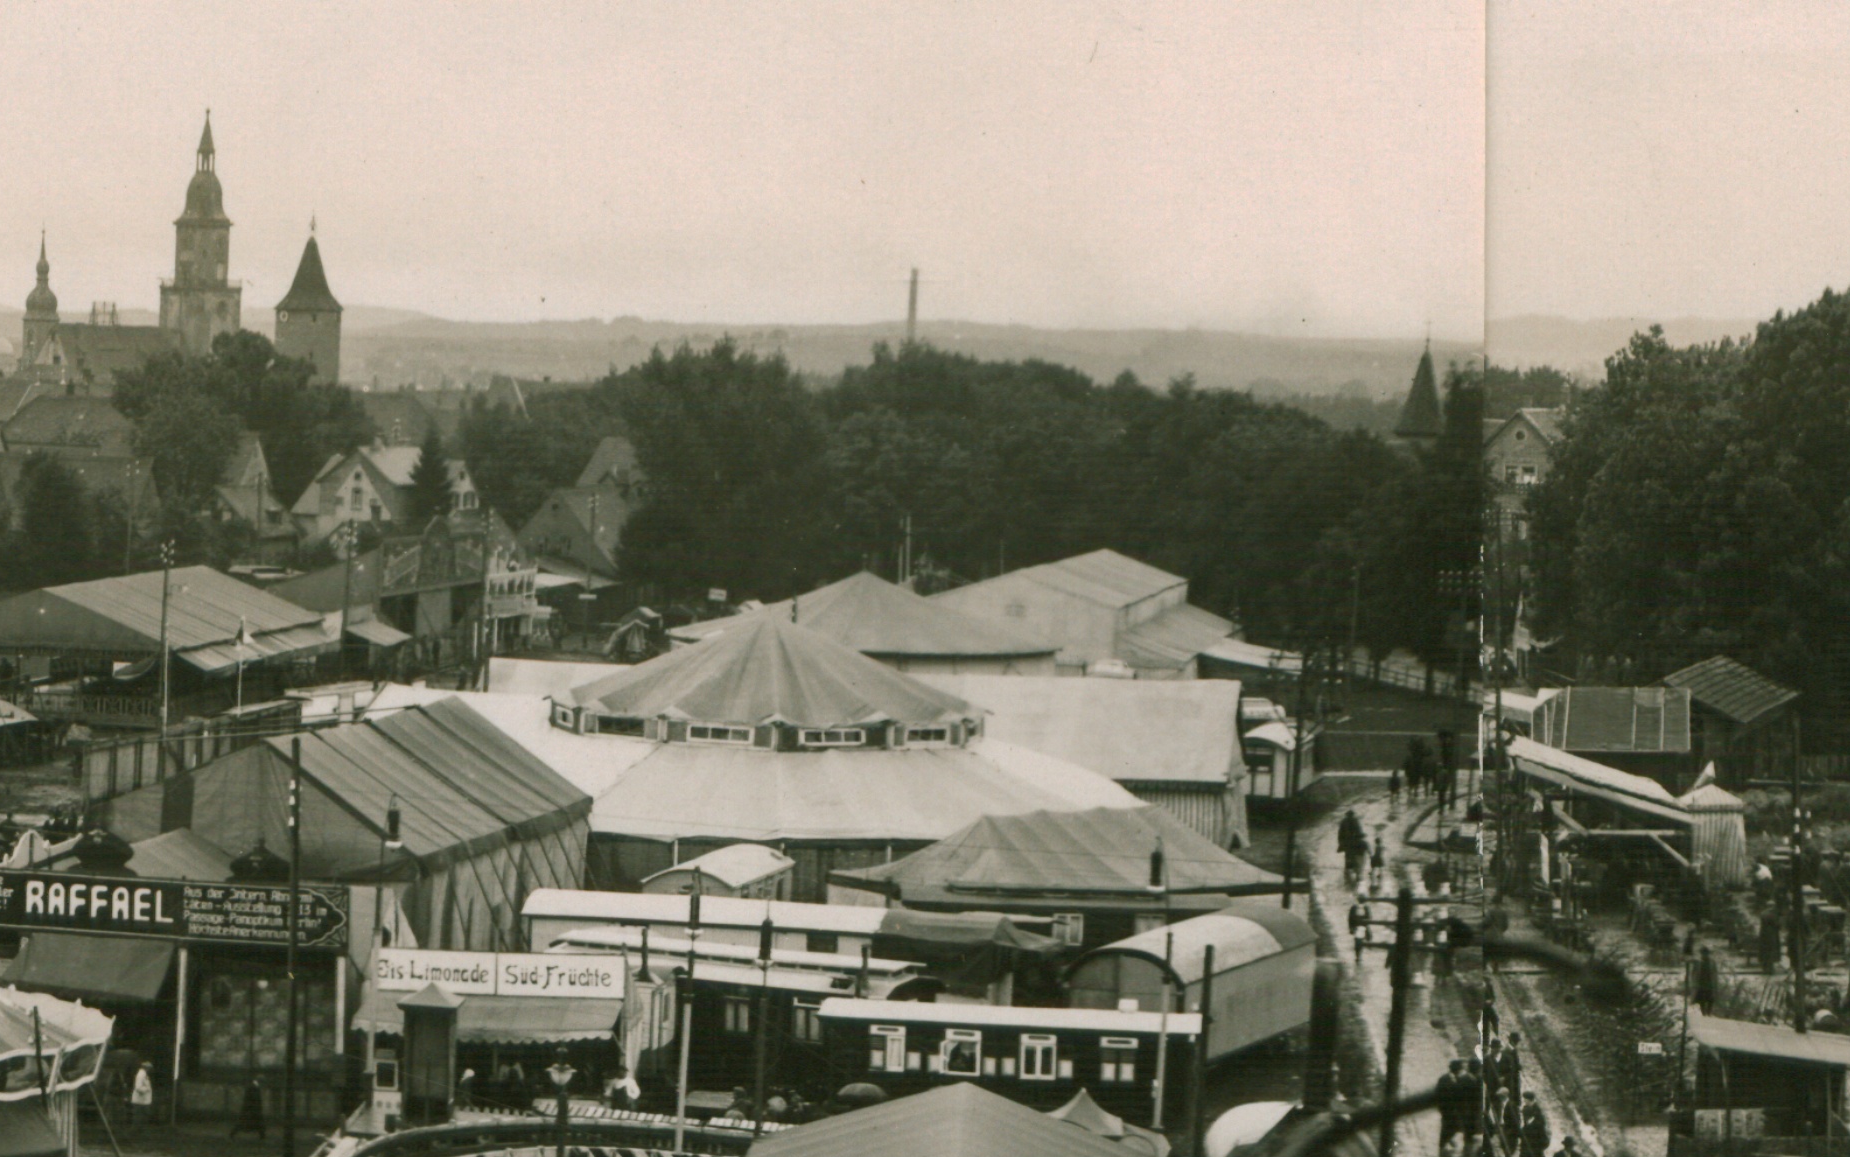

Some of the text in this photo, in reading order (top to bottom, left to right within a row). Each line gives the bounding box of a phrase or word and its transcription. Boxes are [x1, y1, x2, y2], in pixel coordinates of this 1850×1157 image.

[26, 880, 174, 923] RAFFAEL
[183, 886, 202, 898] Aus
[207, 888, 225, 899] der
